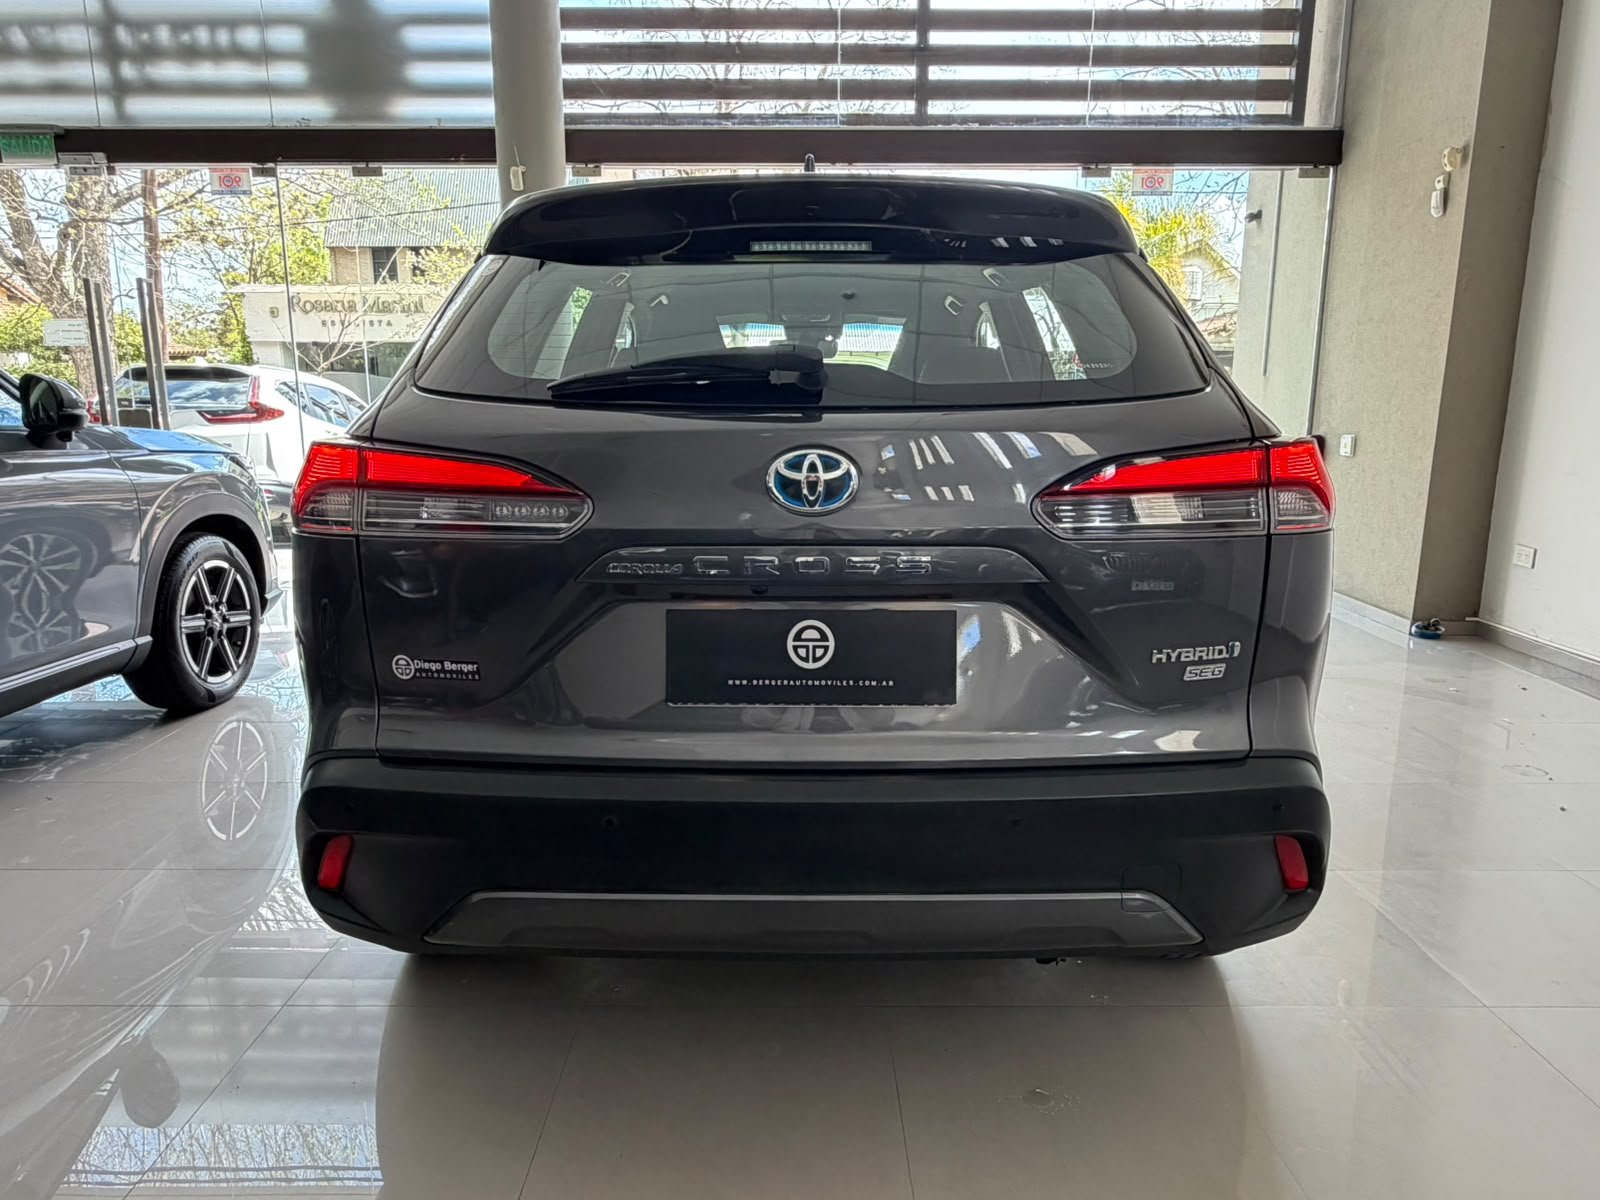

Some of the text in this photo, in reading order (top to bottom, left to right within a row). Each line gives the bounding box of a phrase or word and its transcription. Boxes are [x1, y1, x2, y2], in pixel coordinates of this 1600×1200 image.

[1, 139, 53, 154] SALIDA
[607, 555, 932, 575] COROLLA CROSS
[1151, 645, 1230, 664] HYBRID
[414, 659, 478, 673] Diego Berger
[1186, 665, 1224, 680] SEG
[415, 671, 480, 680] AUTOMOVILES
[727, 679, 895, 687] WWW.BERGERAUTOMOVILES.COM.AR
